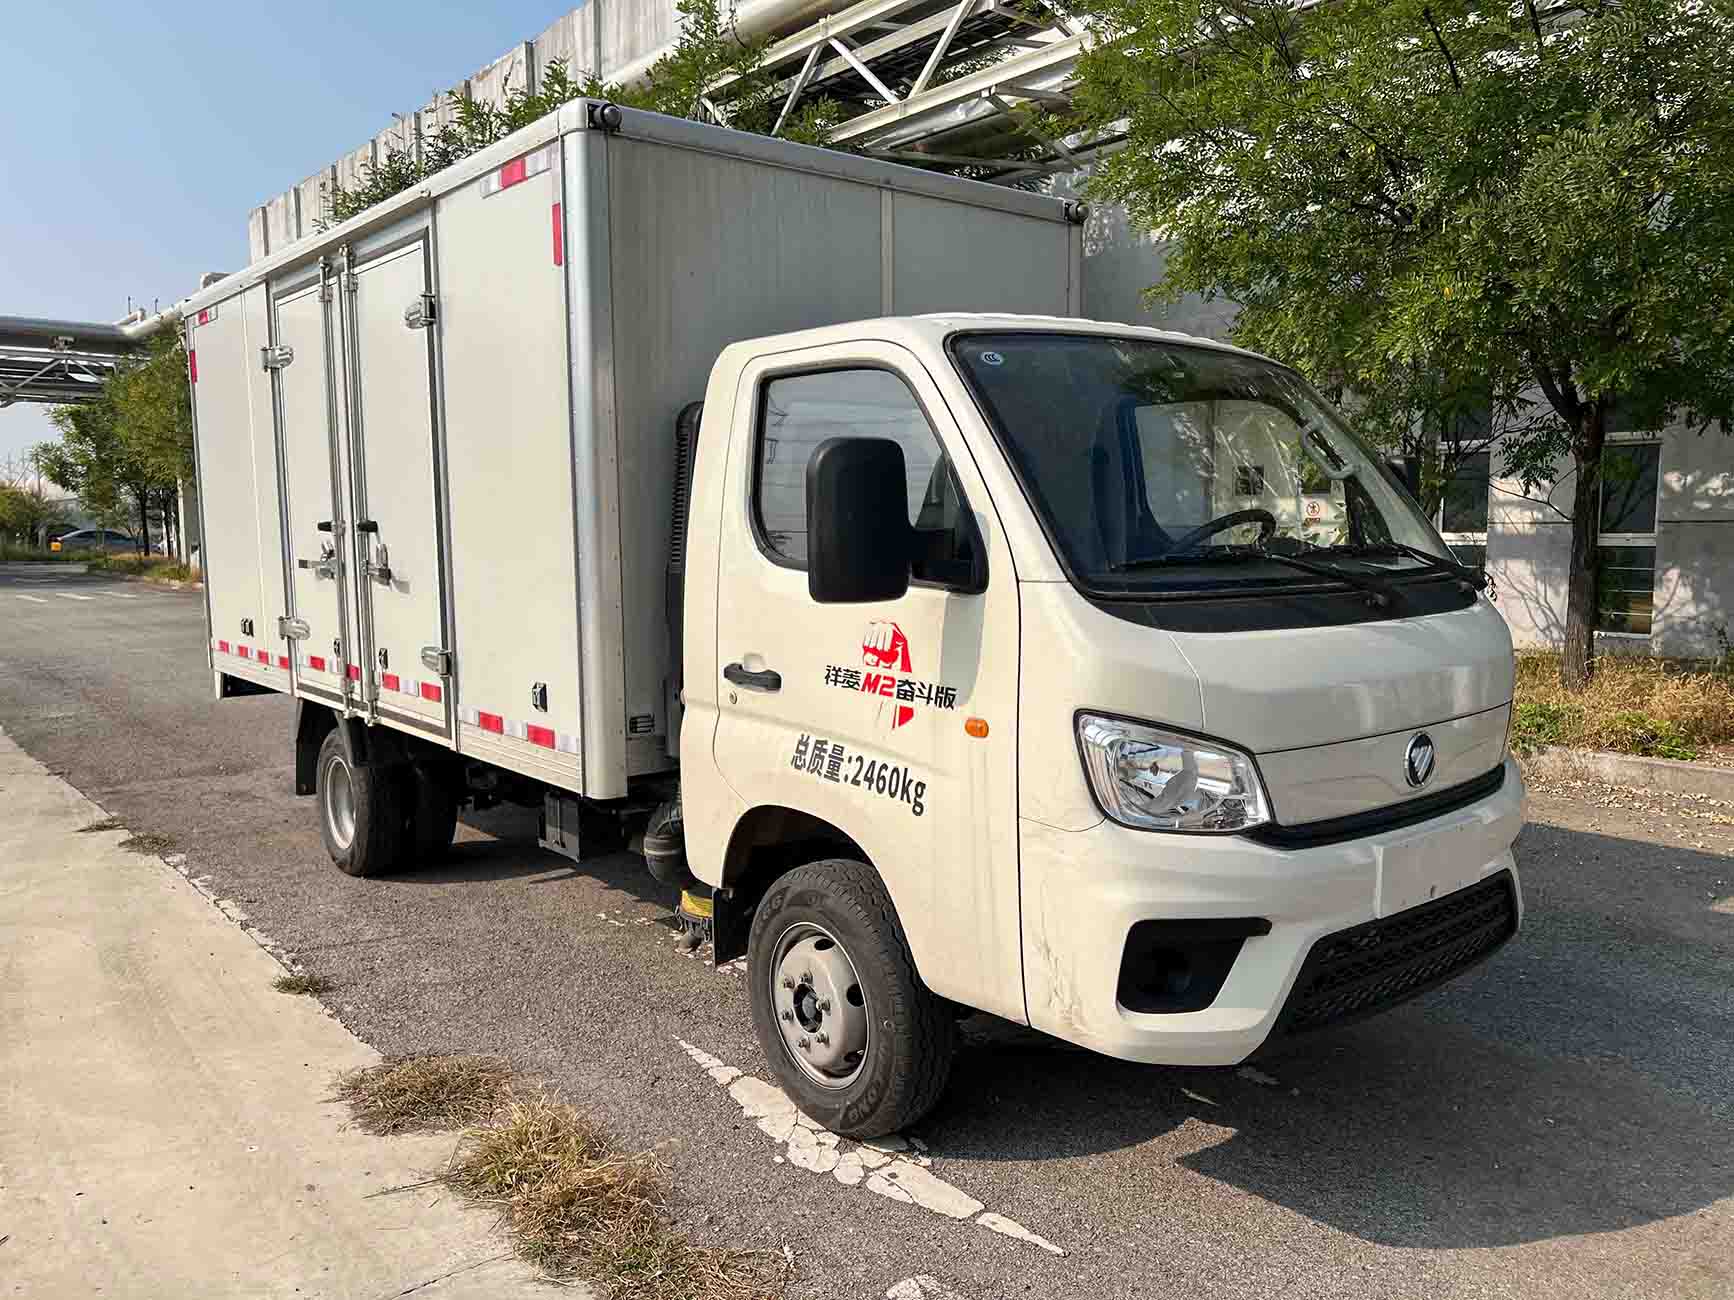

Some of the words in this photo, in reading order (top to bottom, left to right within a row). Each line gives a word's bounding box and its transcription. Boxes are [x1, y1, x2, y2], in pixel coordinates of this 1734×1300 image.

[825, 665, 957, 710] 祥菱M2奋斗版
[791, 734, 926, 816] 总质量:2460kg
